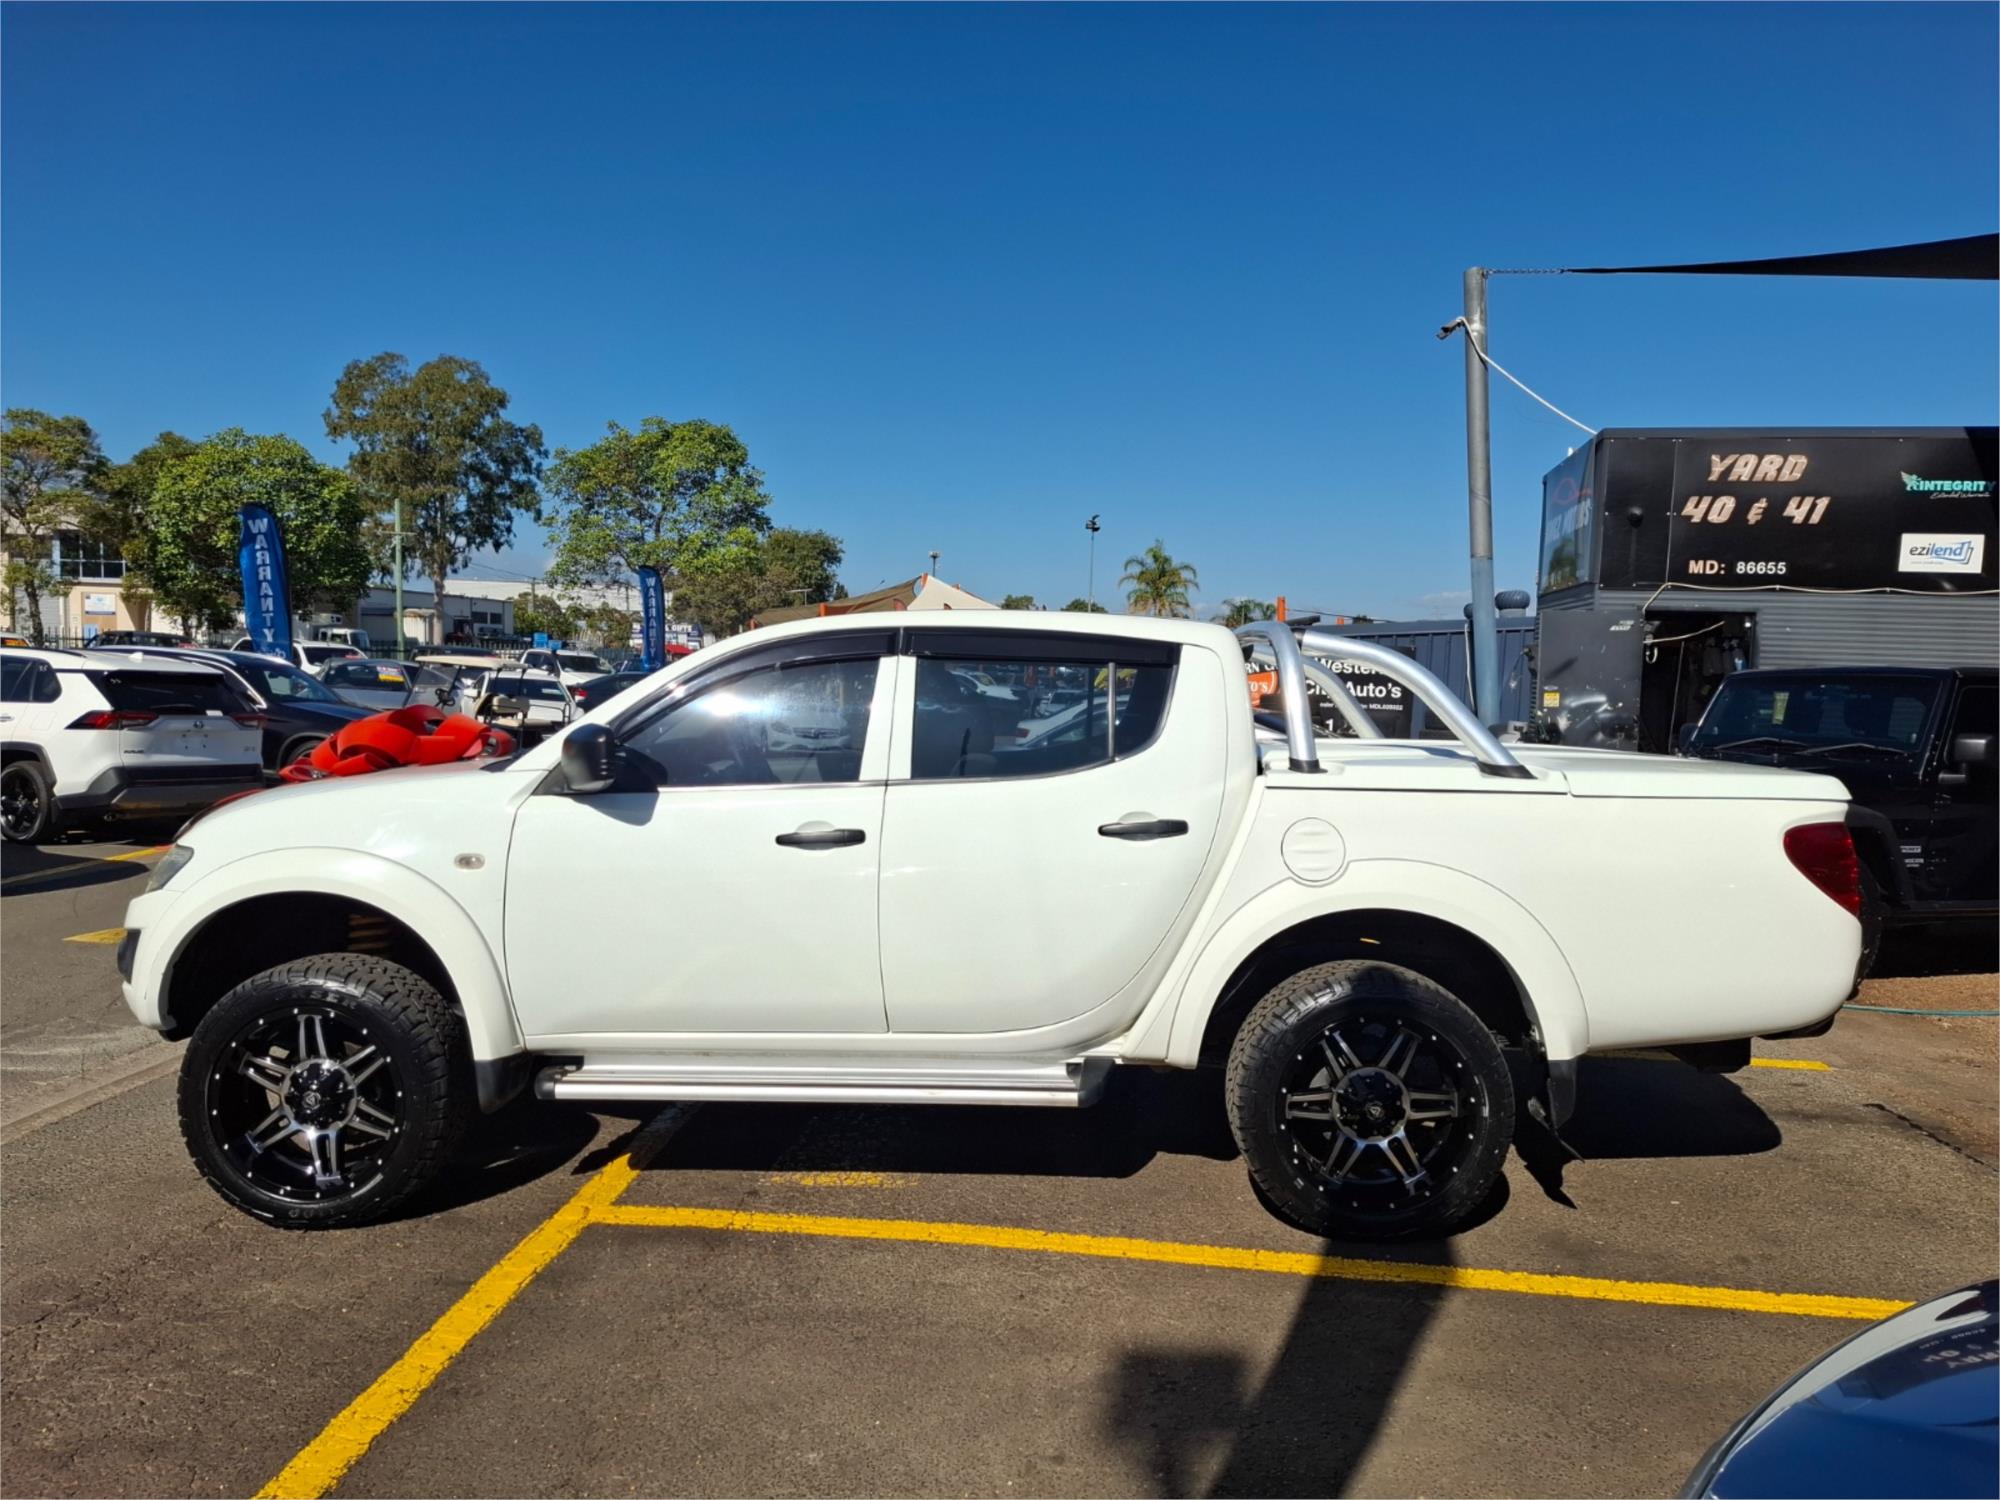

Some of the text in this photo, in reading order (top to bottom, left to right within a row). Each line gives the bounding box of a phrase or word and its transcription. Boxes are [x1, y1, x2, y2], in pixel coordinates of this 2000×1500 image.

[1707, 453, 1809, 482] YARD
[1681, 495, 1832, 525] 40 & 41
[1909, 542, 1963, 556] ezilend
[1688, 559, 1787, 575] MD: 86655
[1346, 681, 1402, 698] Auto's
